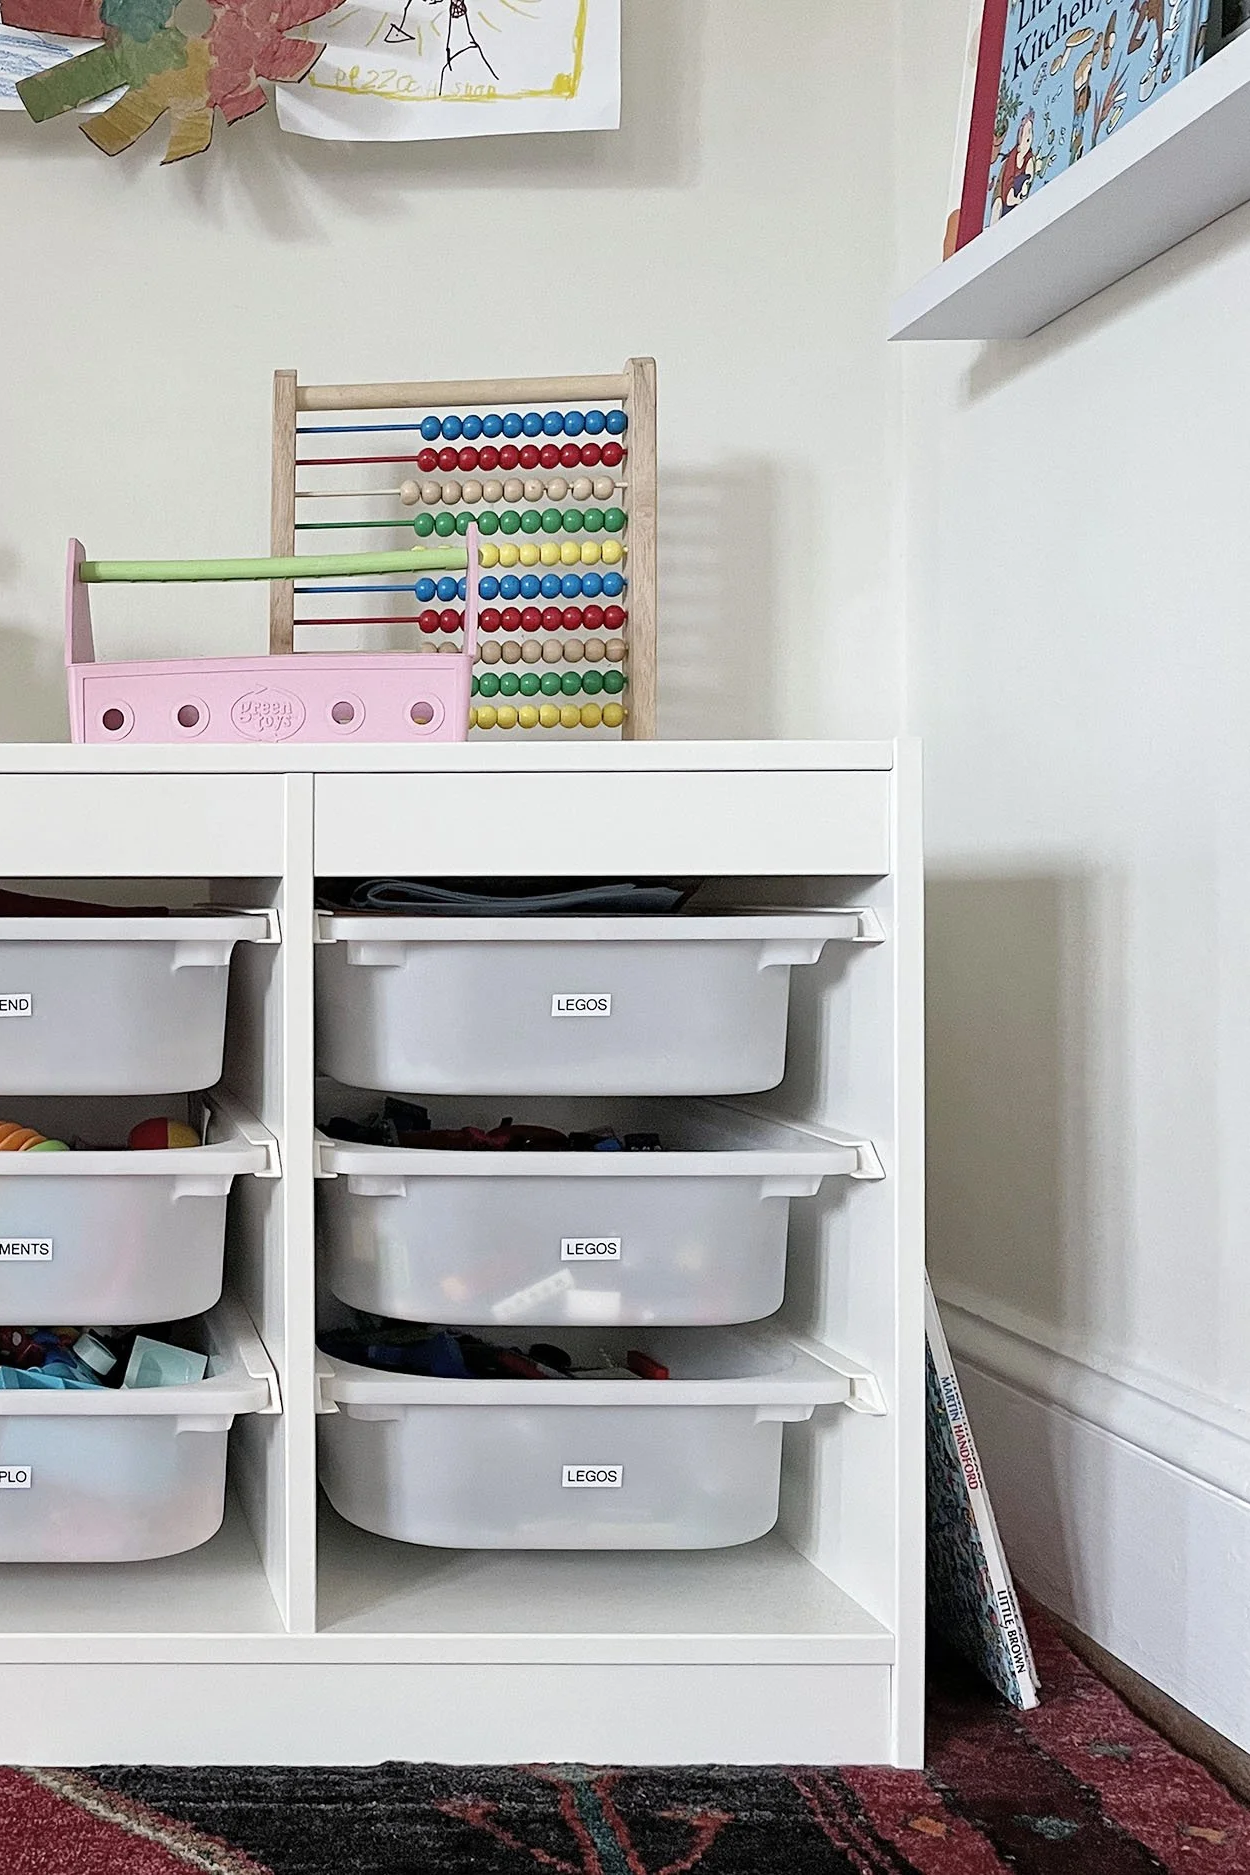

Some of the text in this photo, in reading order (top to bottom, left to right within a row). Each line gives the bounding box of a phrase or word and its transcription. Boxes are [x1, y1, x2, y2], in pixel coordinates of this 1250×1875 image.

[239, 702, 292, 723] green
[258, 713, 292, 733] toys
[557, 998, 608, 1011] LEGOS
[566, 1242, 617, 1255] LEGOS
[940, 1376, 961, 1421] MARTIN
[953, 1423, 979, 1490] HANDFORD
[567, 1470, 618, 1483] LEGOS
[997, 1590, 1015, 1630] LITTLE,
[1007, 1630, 1026, 1674] BROWN
